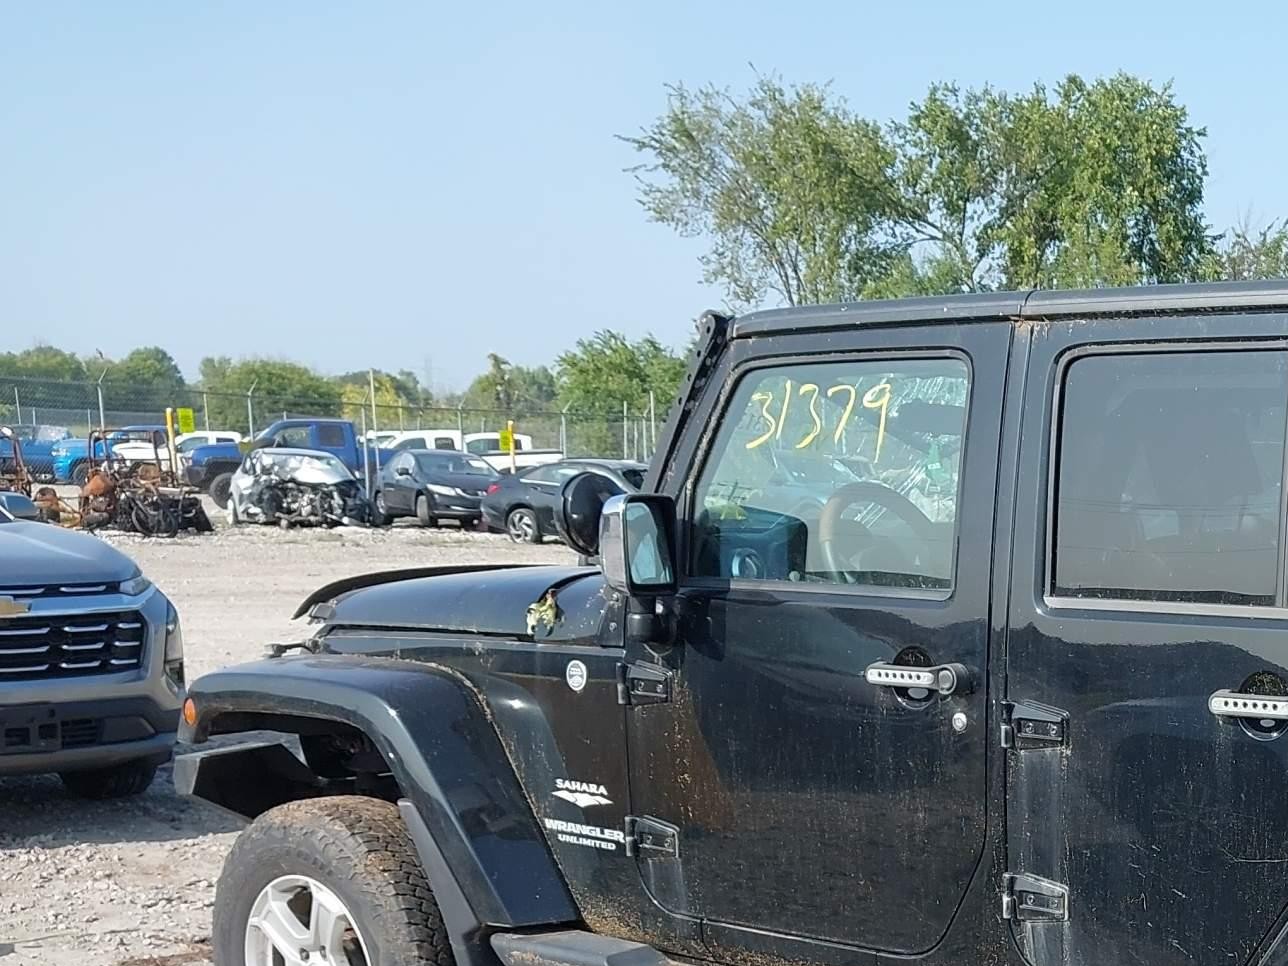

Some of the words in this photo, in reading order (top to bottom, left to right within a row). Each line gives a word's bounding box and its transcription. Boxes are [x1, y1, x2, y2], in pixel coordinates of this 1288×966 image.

[745, 378, 893, 465] 31379
[555, 778, 608, 795] SAHARA
[544, 817, 625, 844] WRANGLER
[557, 833, 617, 851] UNLIMITED
